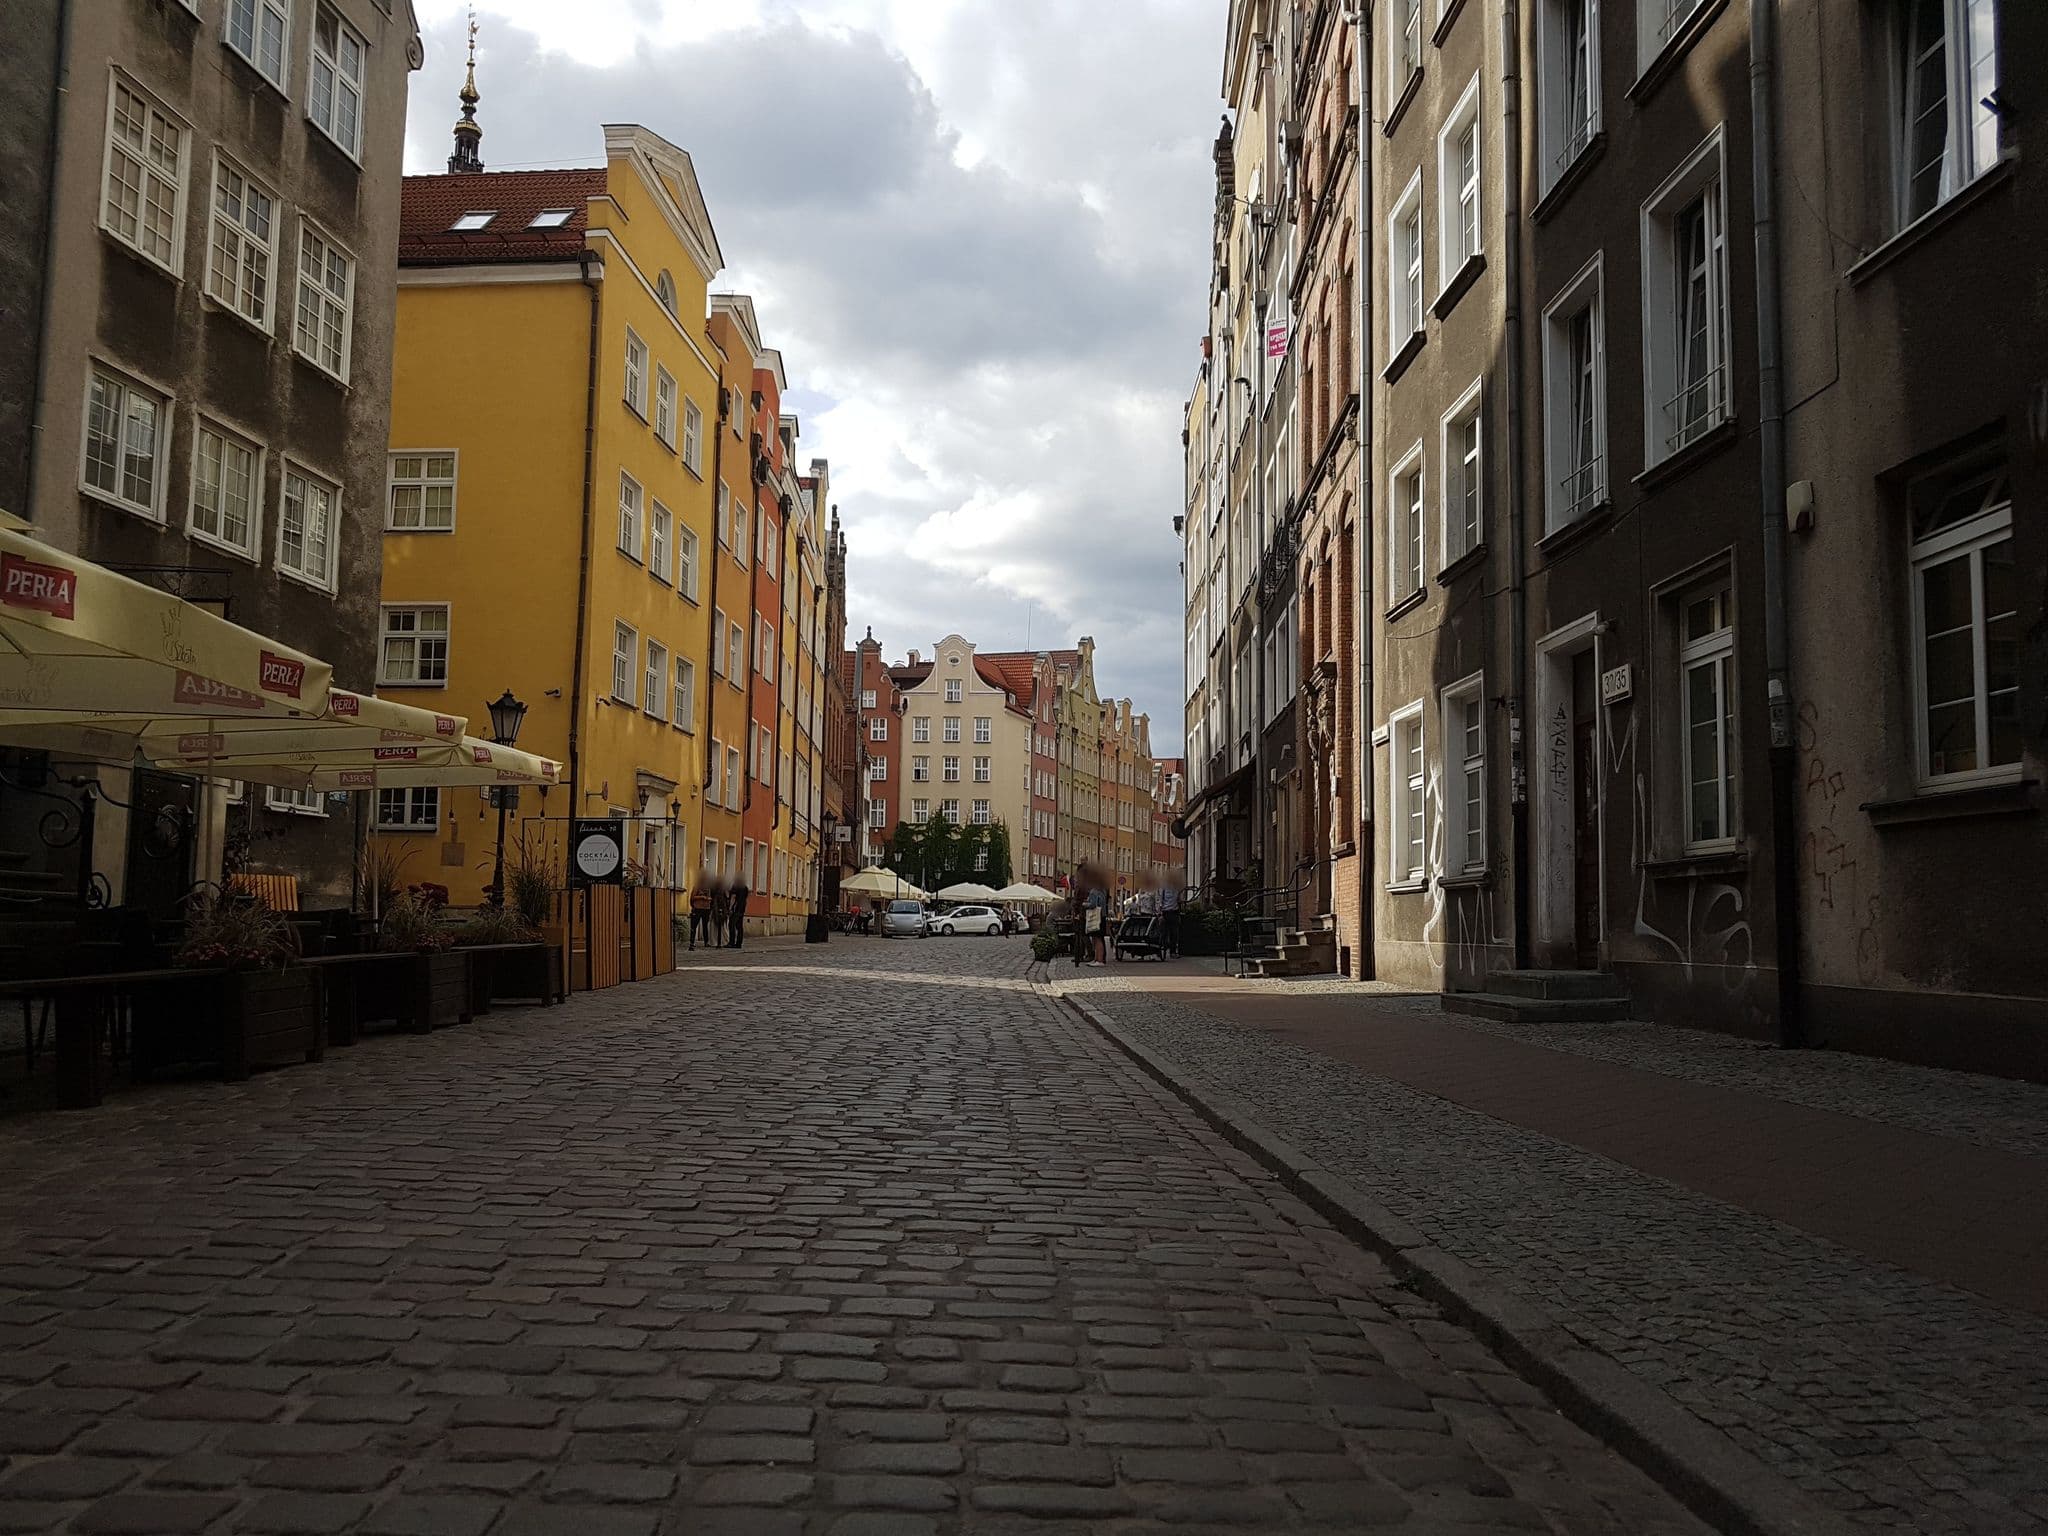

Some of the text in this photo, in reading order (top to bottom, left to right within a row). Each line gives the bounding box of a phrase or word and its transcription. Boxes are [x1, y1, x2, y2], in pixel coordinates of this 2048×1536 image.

[5, 568, 70, 604] PERŁA
[262, 661, 301, 688] PERŁA
[579, 850, 617, 859] COCKTAIL
